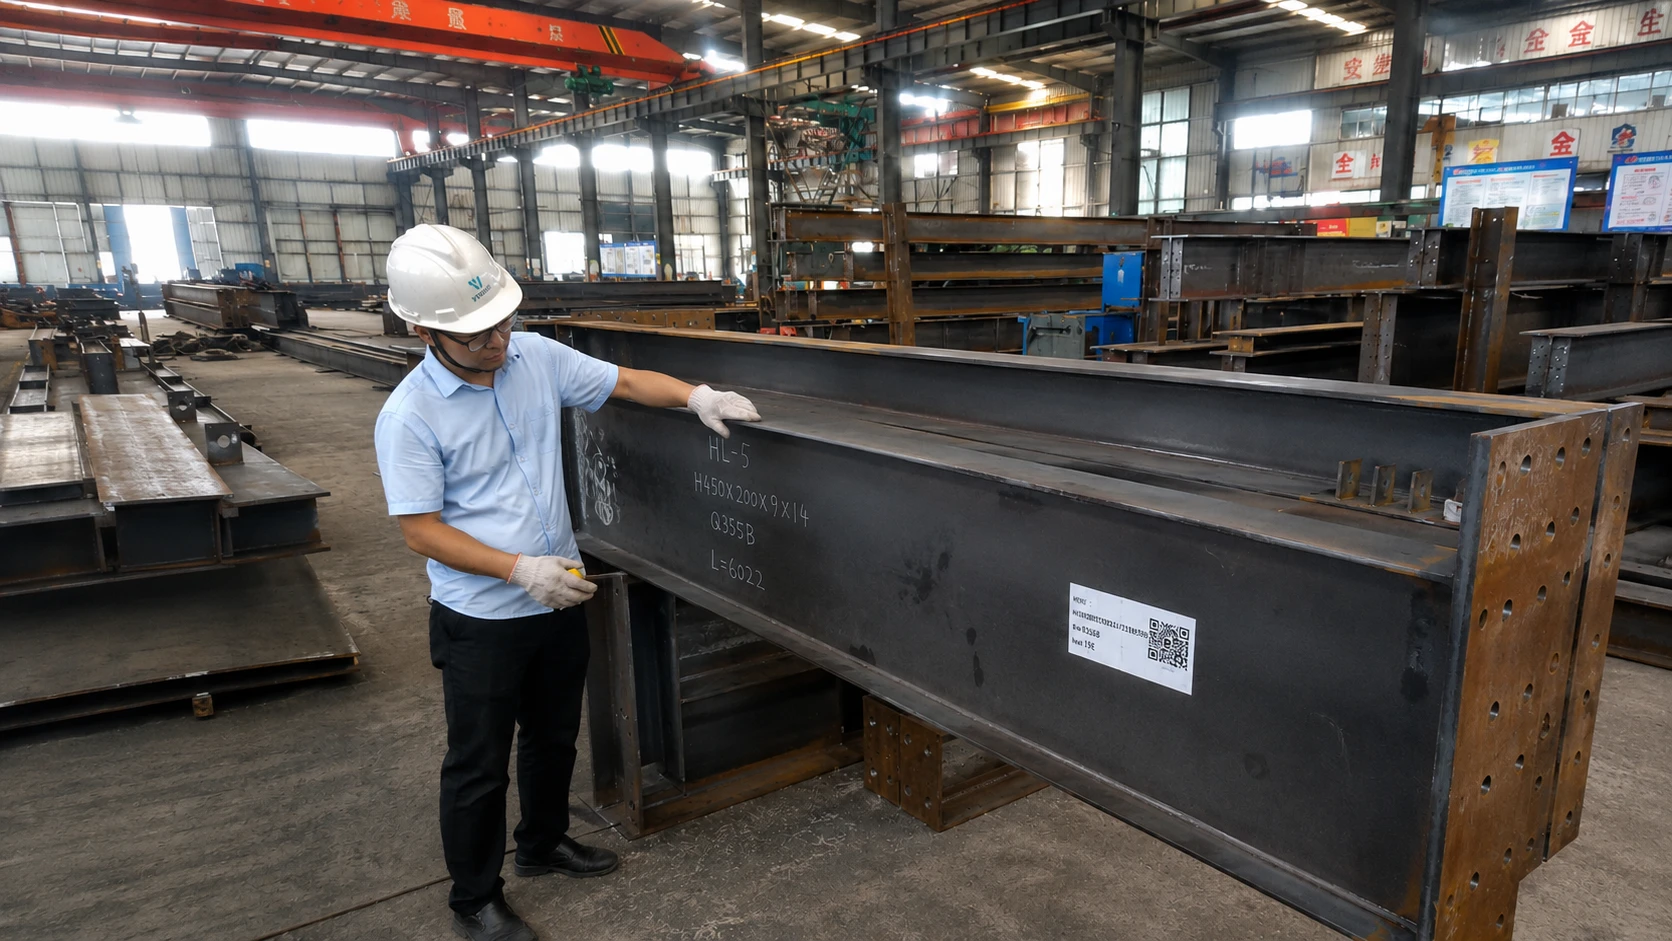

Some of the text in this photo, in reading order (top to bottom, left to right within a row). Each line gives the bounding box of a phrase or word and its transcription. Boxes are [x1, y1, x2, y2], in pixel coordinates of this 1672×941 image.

[1335, 152, 1354, 174] 全
[709, 436, 750, 468] HL-5
[694, 472, 809, 527] H450X200X9X14
[711, 511, 756, 545] Q355B
[711, 549, 765, 591] L=6022
